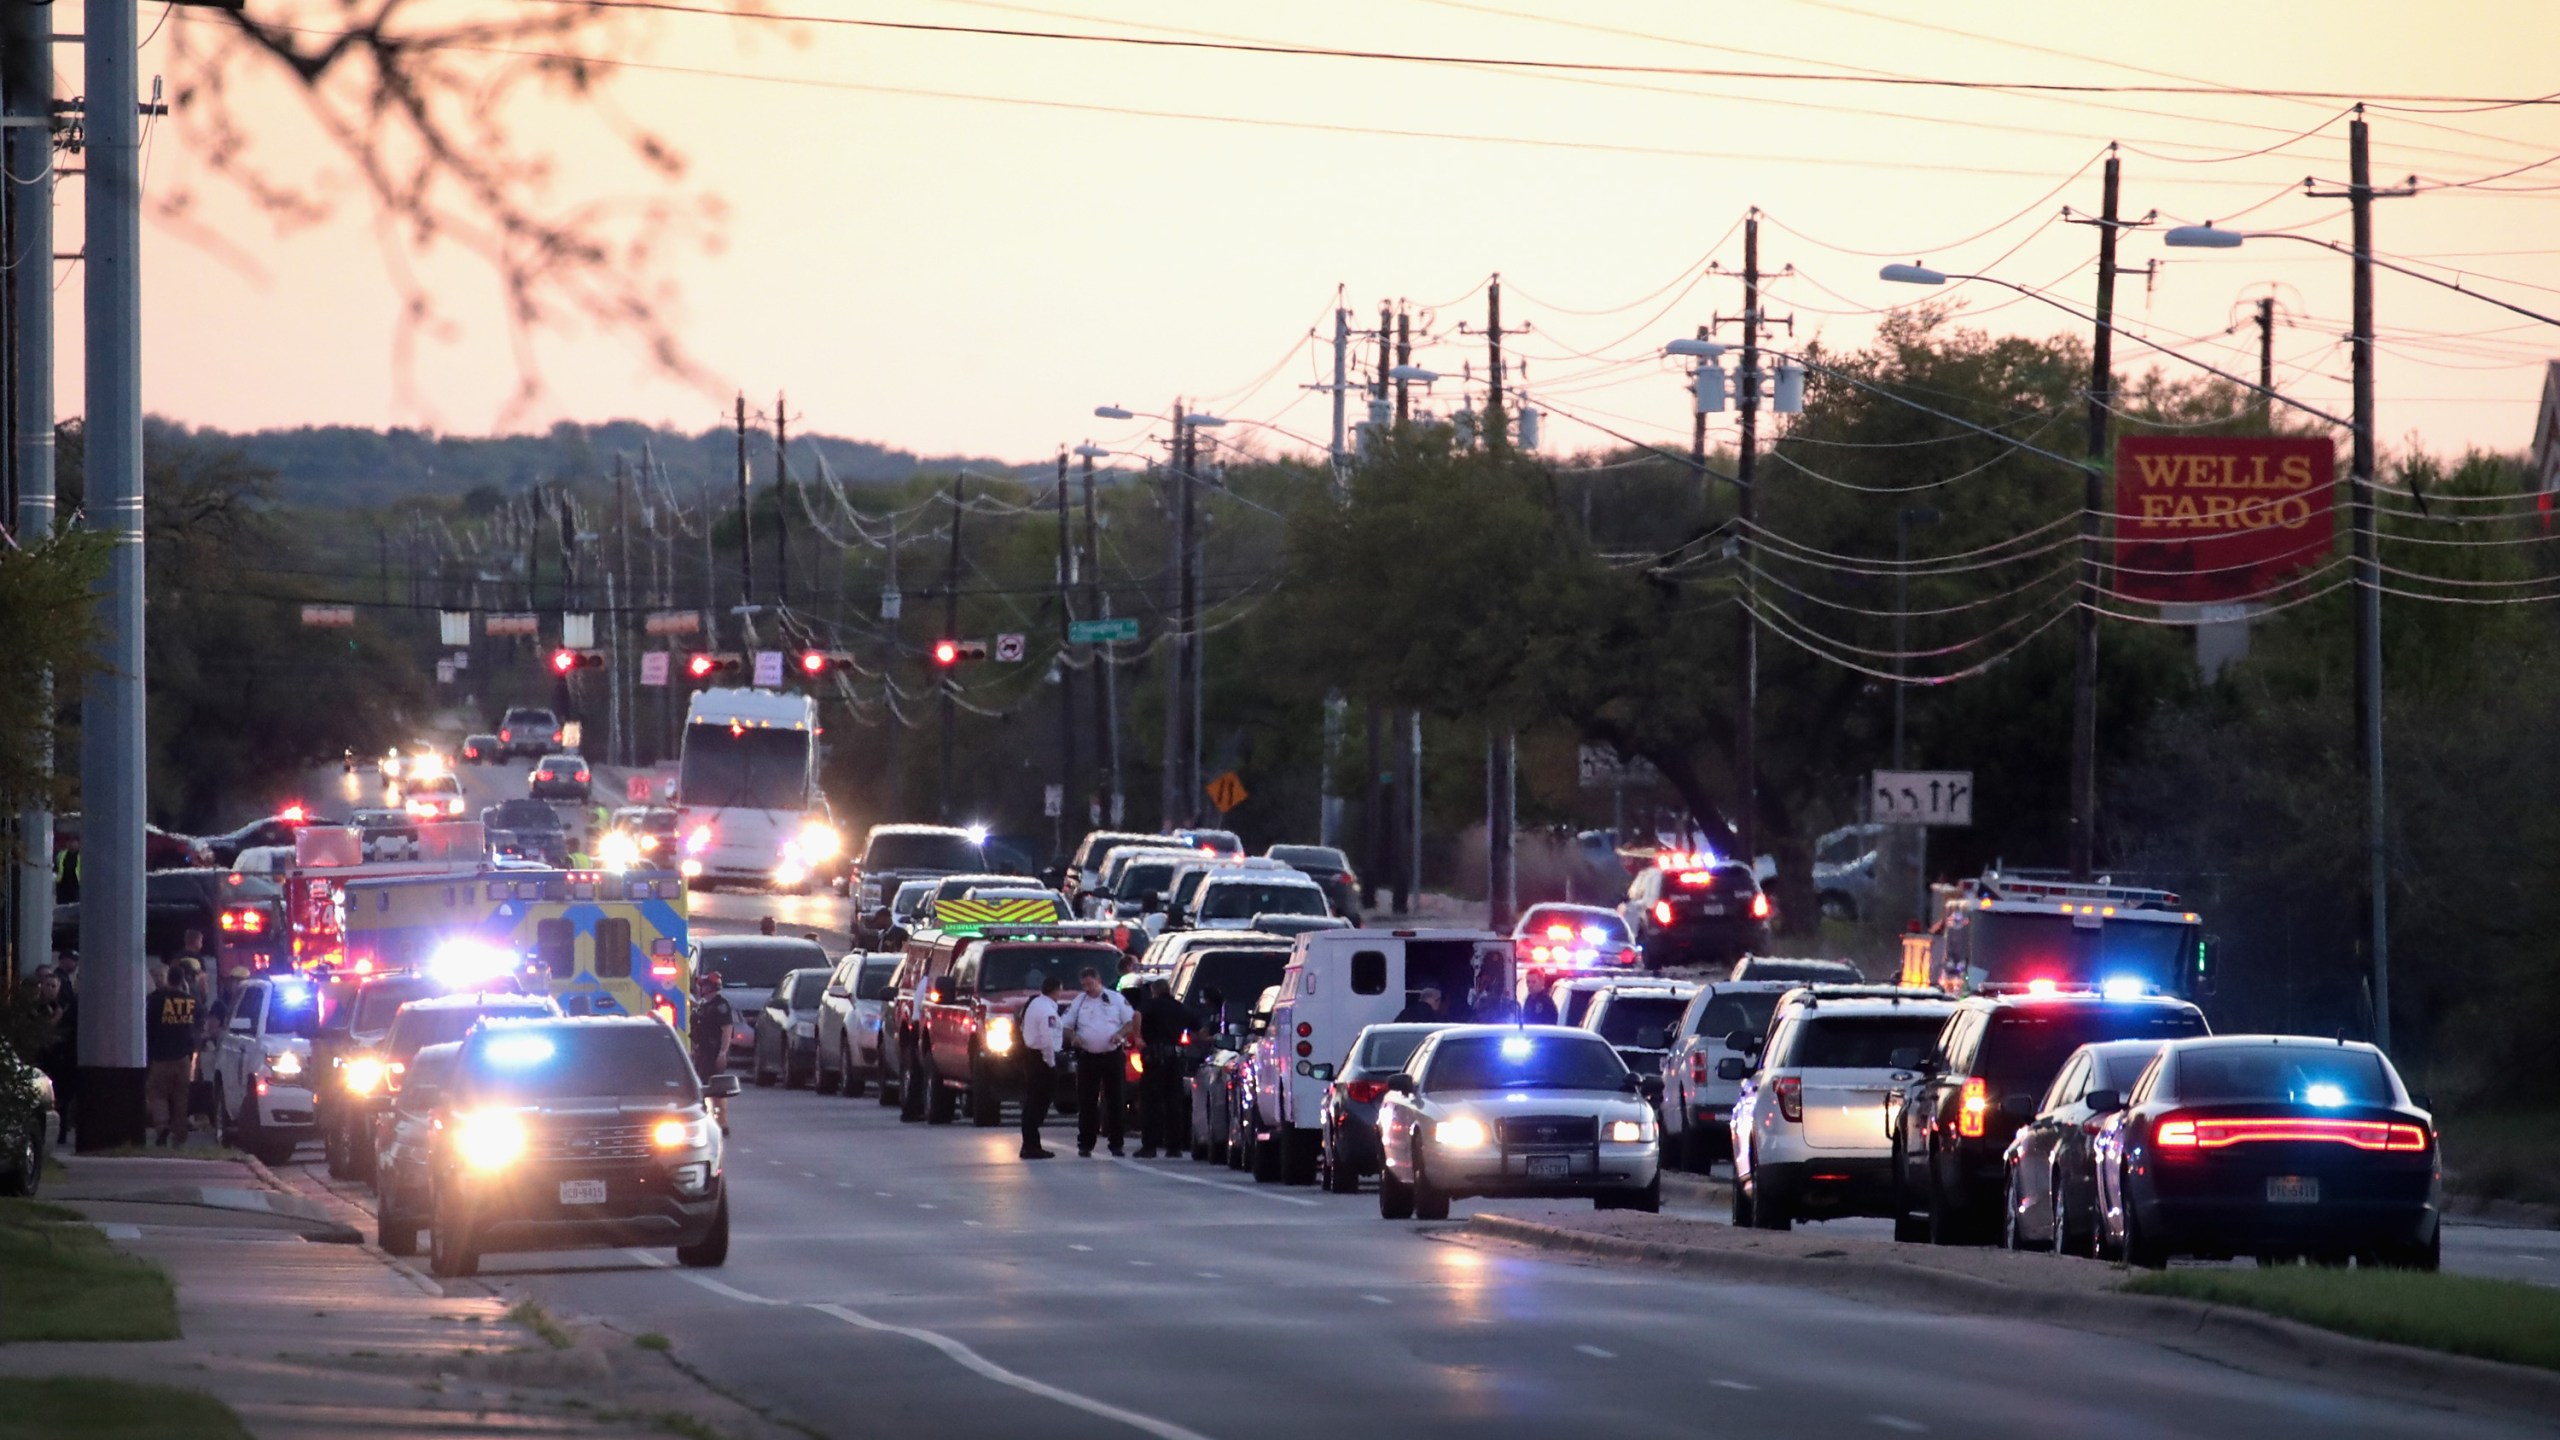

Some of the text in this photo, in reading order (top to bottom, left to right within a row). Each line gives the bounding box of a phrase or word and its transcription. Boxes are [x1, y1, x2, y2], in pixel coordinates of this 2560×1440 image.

[2135, 455, 2312, 489] WELLS
[2138, 494, 2311, 530] FARGO
[162, 997, 196, 1015] ATF
[161, 1014, 195, 1025] POLICE
